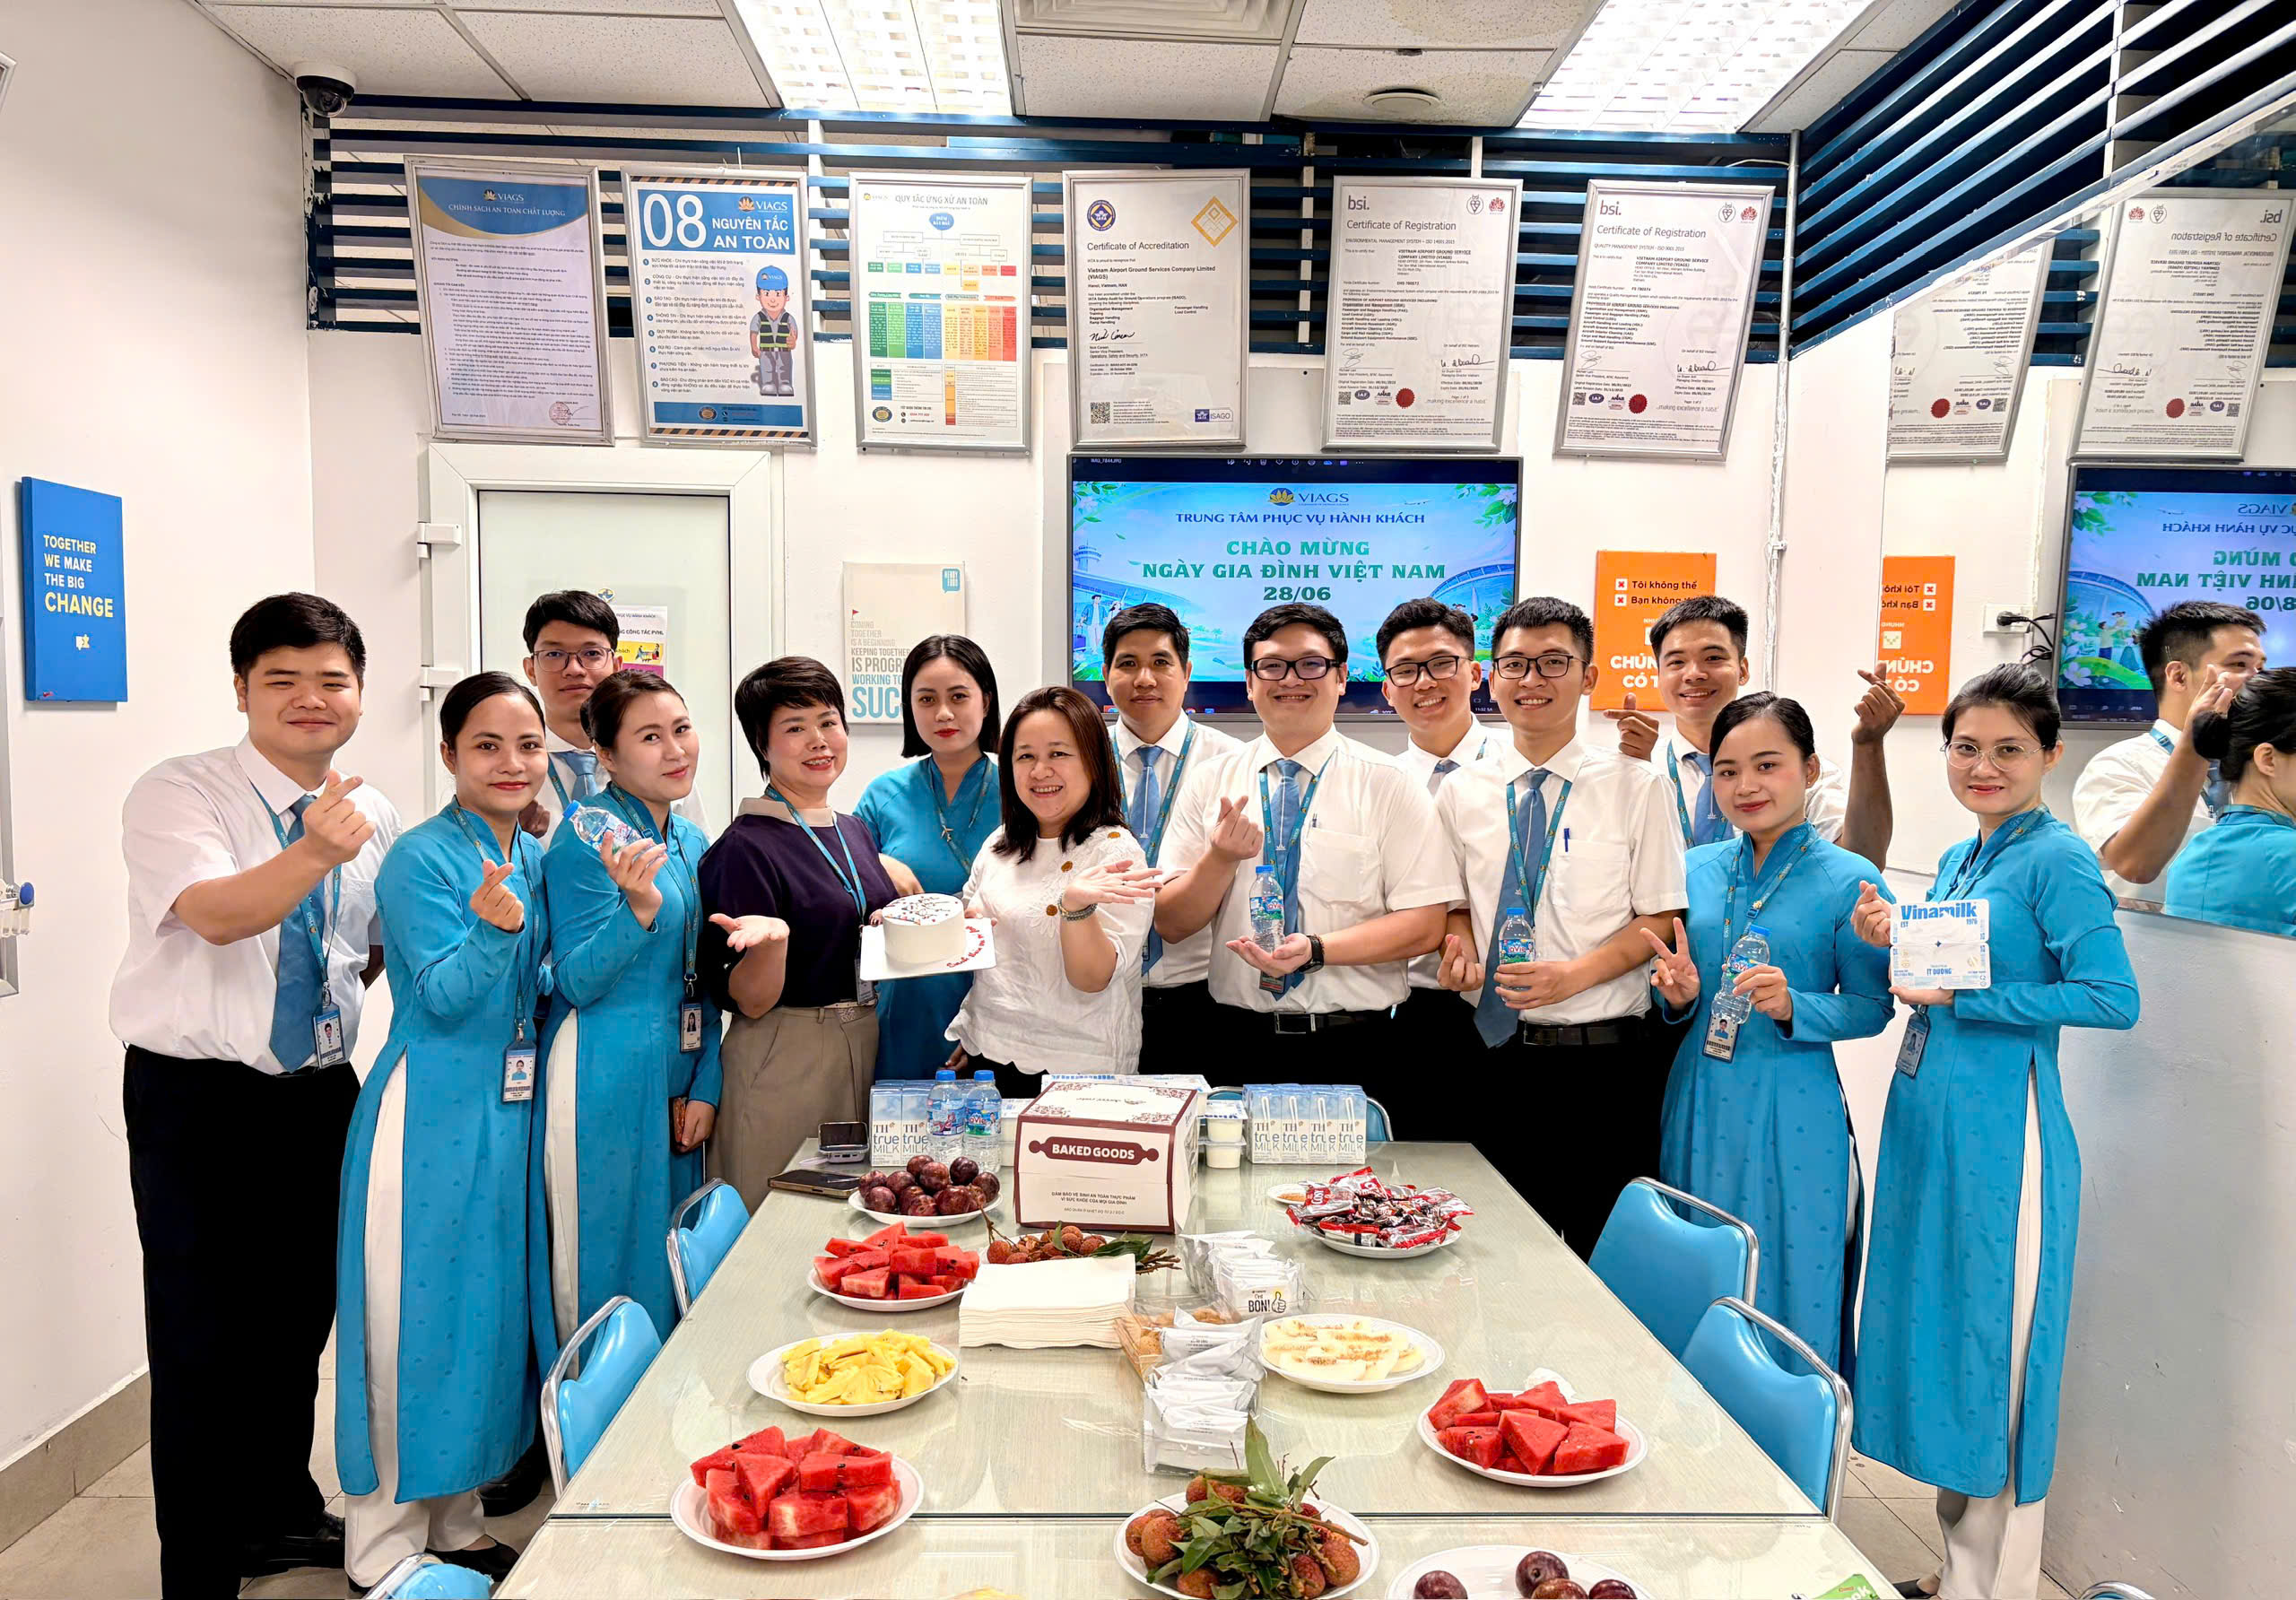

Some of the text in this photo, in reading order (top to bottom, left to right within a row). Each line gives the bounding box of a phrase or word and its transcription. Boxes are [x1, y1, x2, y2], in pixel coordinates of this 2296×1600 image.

[497, 193, 524, 202] VIAGS
[895, 195, 911, 203] QUY
[956, 196, 968, 204] AN
[1347, 195, 1370, 211] bsi.
[754, 200, 788, 212] VIAGS
[1599, 199, 1622, 216] bsi.
[643, 193, 707, 248] 08
[712, 214, 788, 231] NGUYÊN TẮC
[1346, 219, 1457, 232] Certificate of Registration
[1596, 224, 1707, 239] Certificate of Registration
[713, 233, 790, 250] AN TOÀN
[1087, 241, 1190, 251] Certificate of Accreditation
[1298, 492, 1350, 503] VIAGS
[1176, 511, 1425, 526] TRUNG TÂM PHỤC VỤ HÀNH KHÁCH
[43, 534, 97, 554] TOGETHER
[1226, 536, 1370, 556] CHÀO MỪNG
[43, 552, 92, 573] WE MAKE
[1143, 559, 1446, 583] NGÀY GIA ĐÌNH VIỆT NAM
[44, 572, 86, 589] THE BIG
[1631, 580, 1647, 588] Tôi
[1649, 580, 1679, 591] không
[1263, 587, 1332, 603] 28/06
[1631, 596, 1649, 605] Bạn
[45, 591, 114, 618] CHANGE
[851, 648, 878, 657] KEEPING
[851, 657, 905, 673] IS PROGR
[1610, 652, 1659, 669] CHÚN
[852, 674, 891, 685] WORKING
[1622, 671, 1648, 689] CÓ
[1900, 901, 1977, 920] Vinamilk
[874, 1124, 889, 1134] TH
[902, 1124, 918, 1134] TH
[874, 1134, 900, 1144] true
[902, 1134, 928, 1144] true
[873, 1144, 900, 1154] MILK
[901, 1144, 928, 1154] MILK
[1051, 1143, 1135, 1160] BAKED GOODS
[1248, 1300, 1271, 1313] BON!
